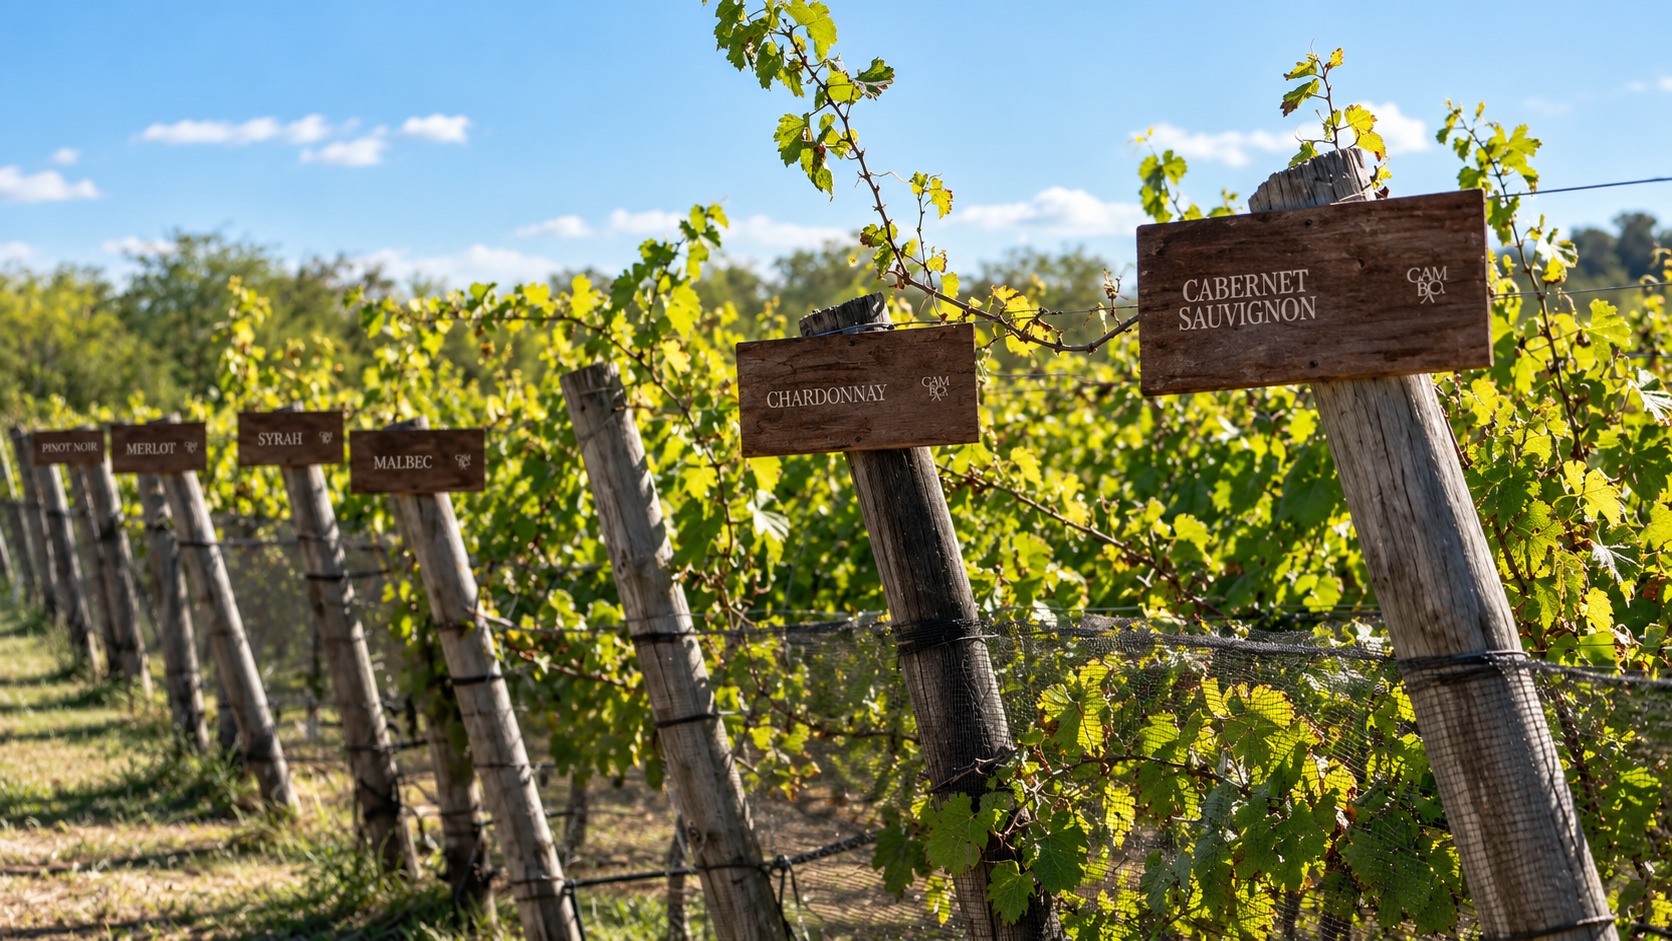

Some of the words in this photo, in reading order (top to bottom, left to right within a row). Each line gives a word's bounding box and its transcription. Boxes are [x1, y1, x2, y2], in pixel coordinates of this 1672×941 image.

[1182, 268, 1309, 303] CABERNET
[1178, 295, 1317, 331] SAUVIGNON
[766, 383, 888, 409] CHARDONNAY
[42, 442, 72, 453] PINOT
[73, 441, 98, 452] NOIR
[258, 431, 303, 447] SYRAH
[126, 441, 177, 456] MERLOT
[373, 454, 433, 470] MALBEC
